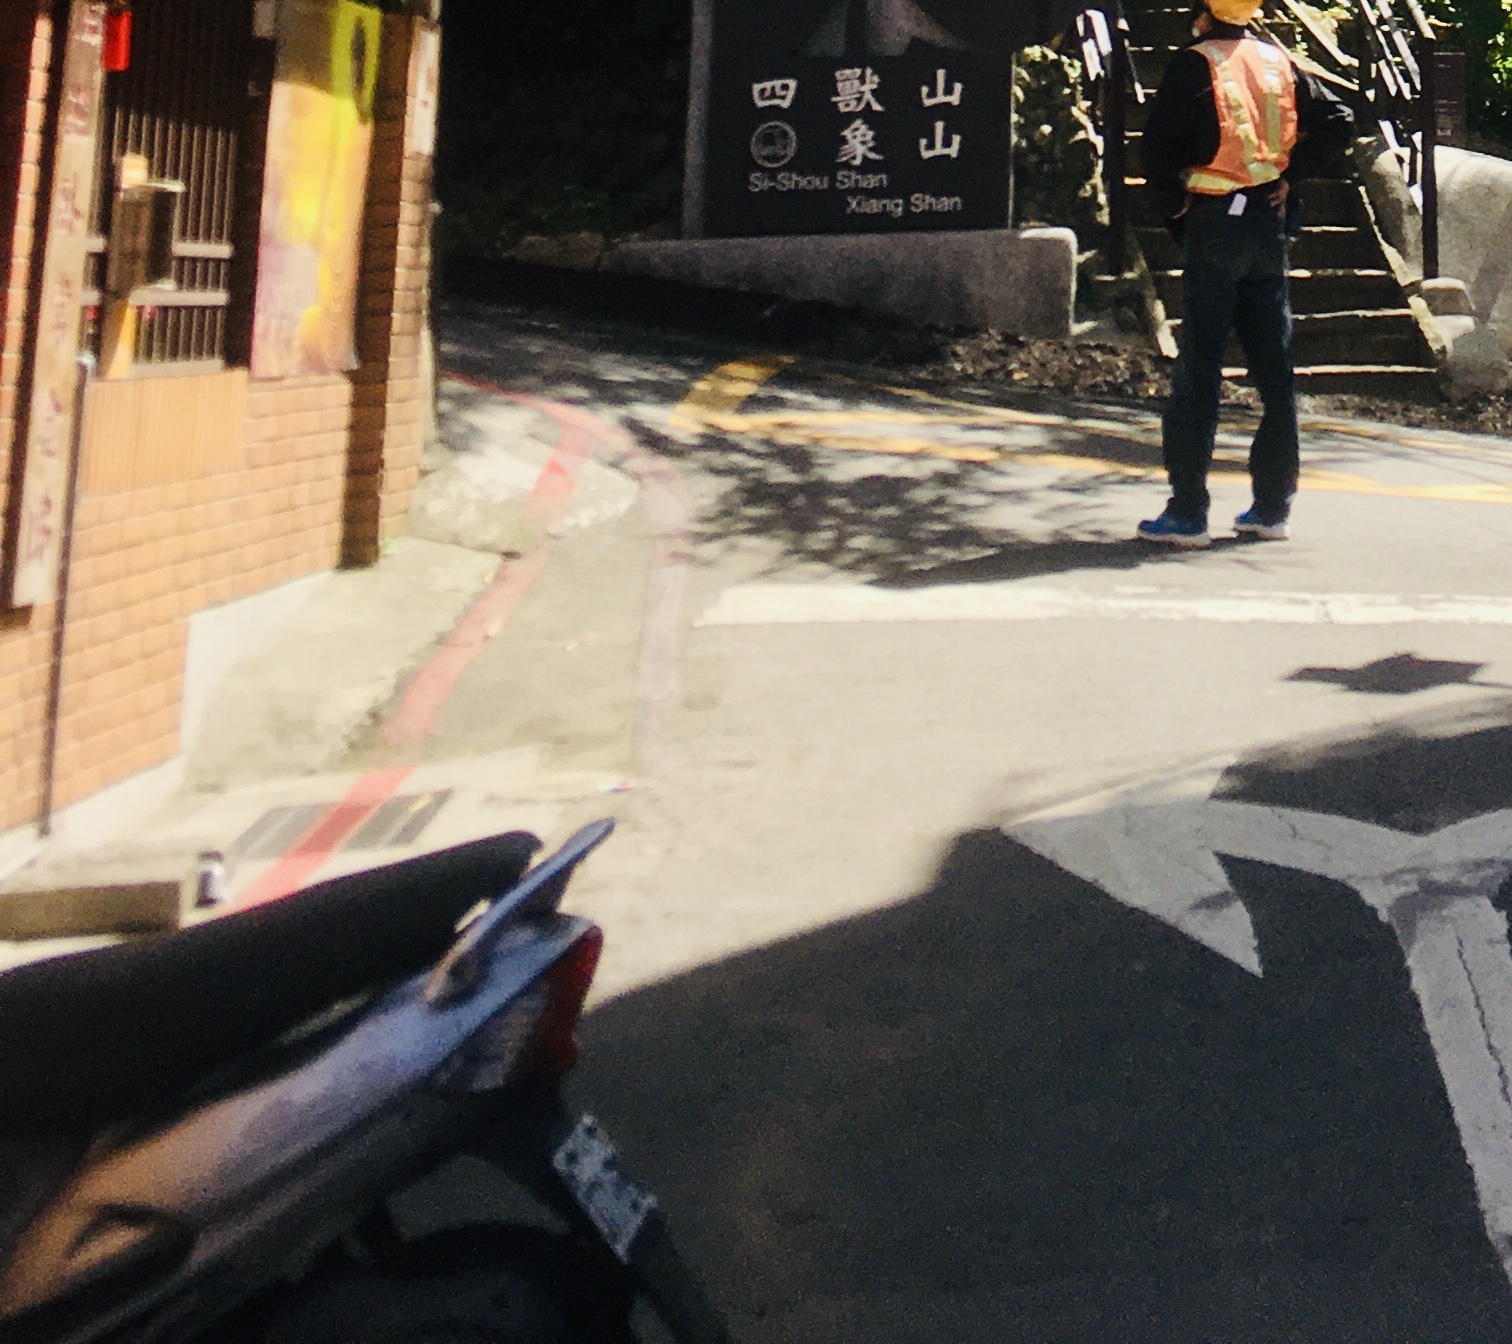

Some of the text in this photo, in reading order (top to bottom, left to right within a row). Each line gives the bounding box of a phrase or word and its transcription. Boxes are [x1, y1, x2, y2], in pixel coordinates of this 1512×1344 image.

[752, 67, 964, 113] 四獸山
[836, 118, 962, 166] 象山
[749, 170, 889, 192] Si-Shou Shan
[846, 193, 963, 218] Xiang Shan
